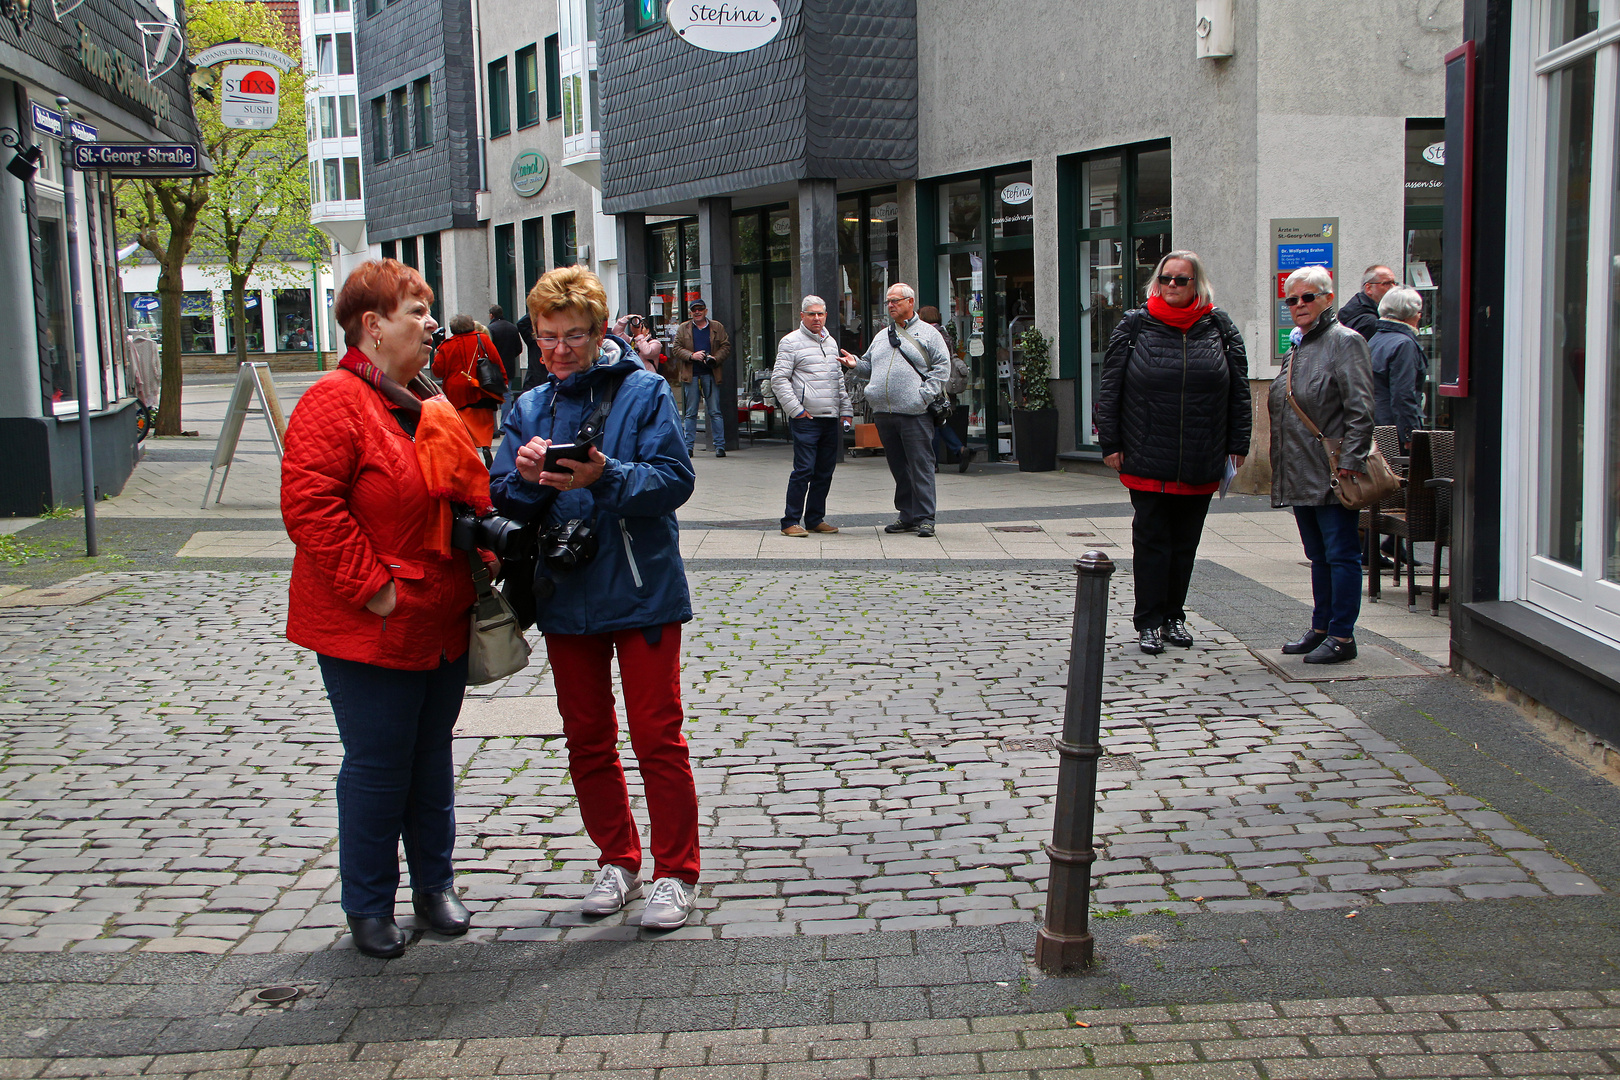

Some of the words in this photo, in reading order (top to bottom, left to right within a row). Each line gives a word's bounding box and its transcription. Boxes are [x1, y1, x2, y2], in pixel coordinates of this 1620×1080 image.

[689, 3, 765, 25] Stefina
[245, 47, 293, 68] RESTAURANT
[225, 79, 274, 94] STIXS
[243, 105, 273, 114] SUSHI
[1429, 180, 1443, 188] Sie
[1002, 185, 1032, 200] Stefina
